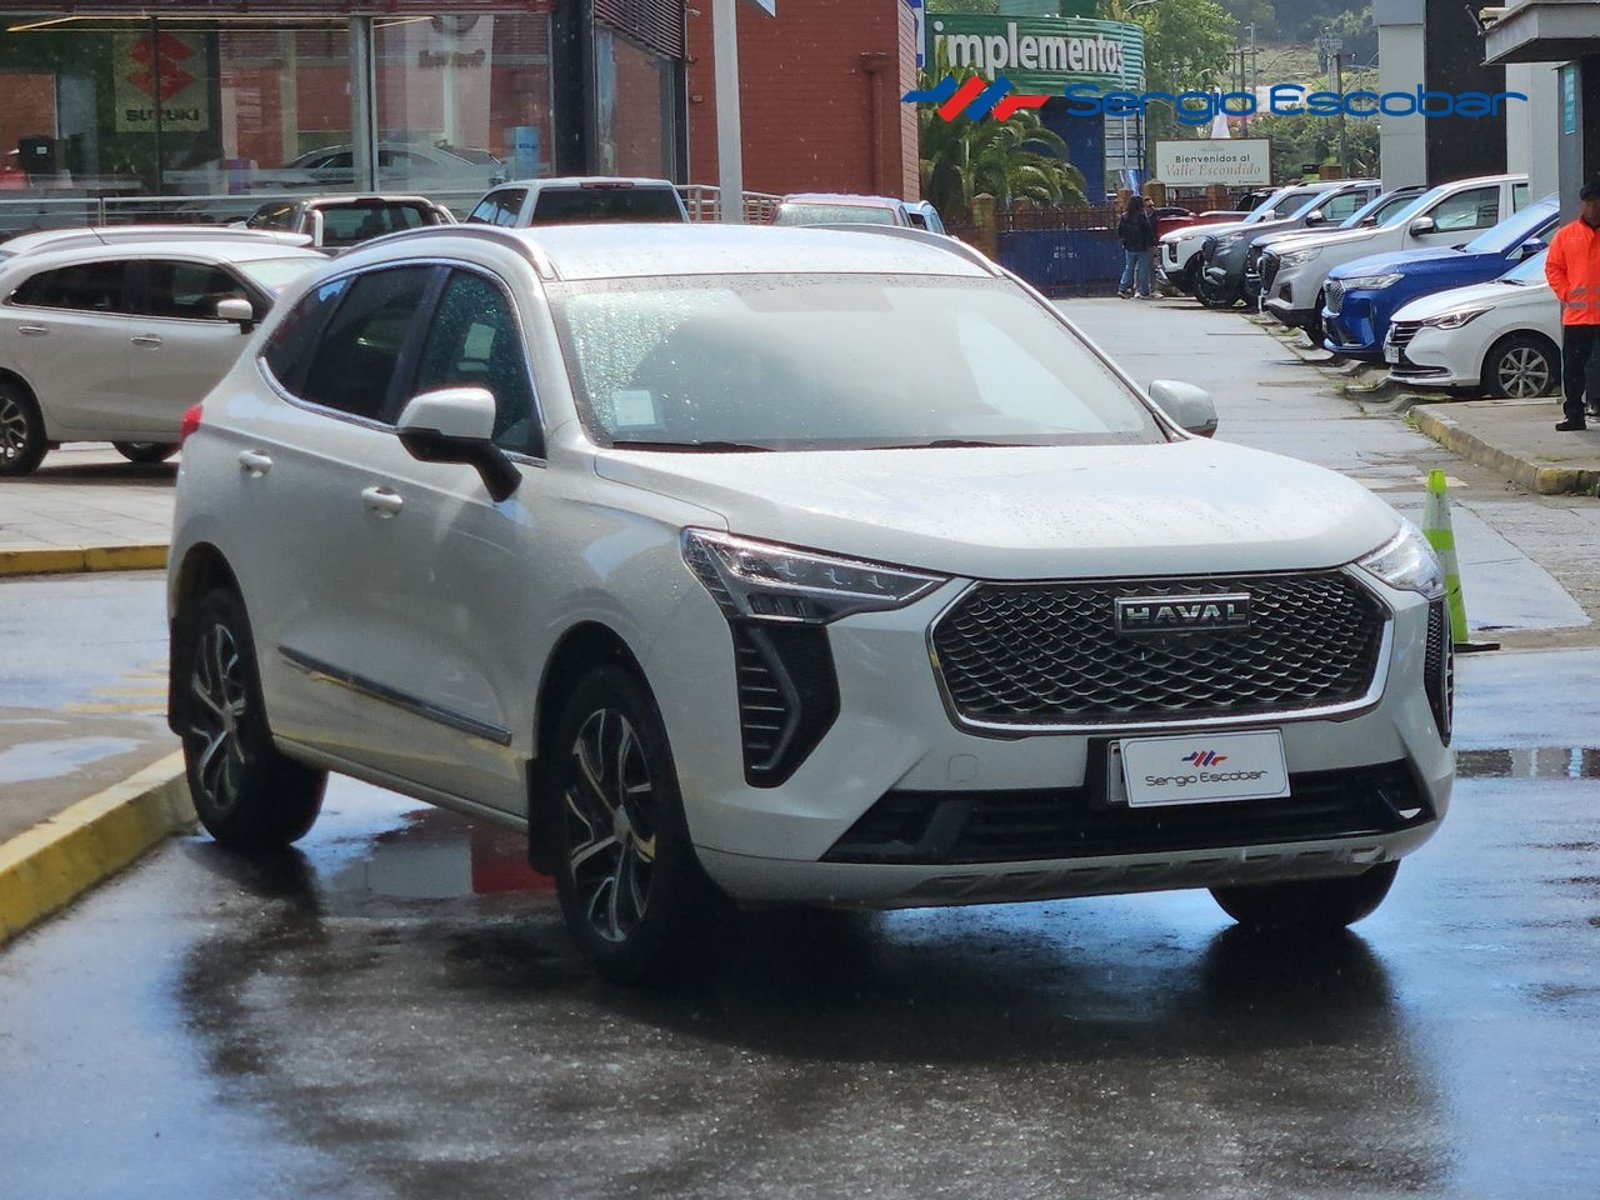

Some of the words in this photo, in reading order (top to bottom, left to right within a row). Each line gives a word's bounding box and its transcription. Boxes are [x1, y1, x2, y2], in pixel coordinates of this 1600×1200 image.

[1175, 154, 1237, 163] Bienvenidos
[1240, 154, 1250, 162] al
[1165, 163, 1195, 177] Valle
[1199, 163, 1261, 176] Escondido
[1126, 603, 1246, 625] HAVAL
[1145, 774, 1198, 787] Sergio
[1200, 769, 1268, 783] Escobar
